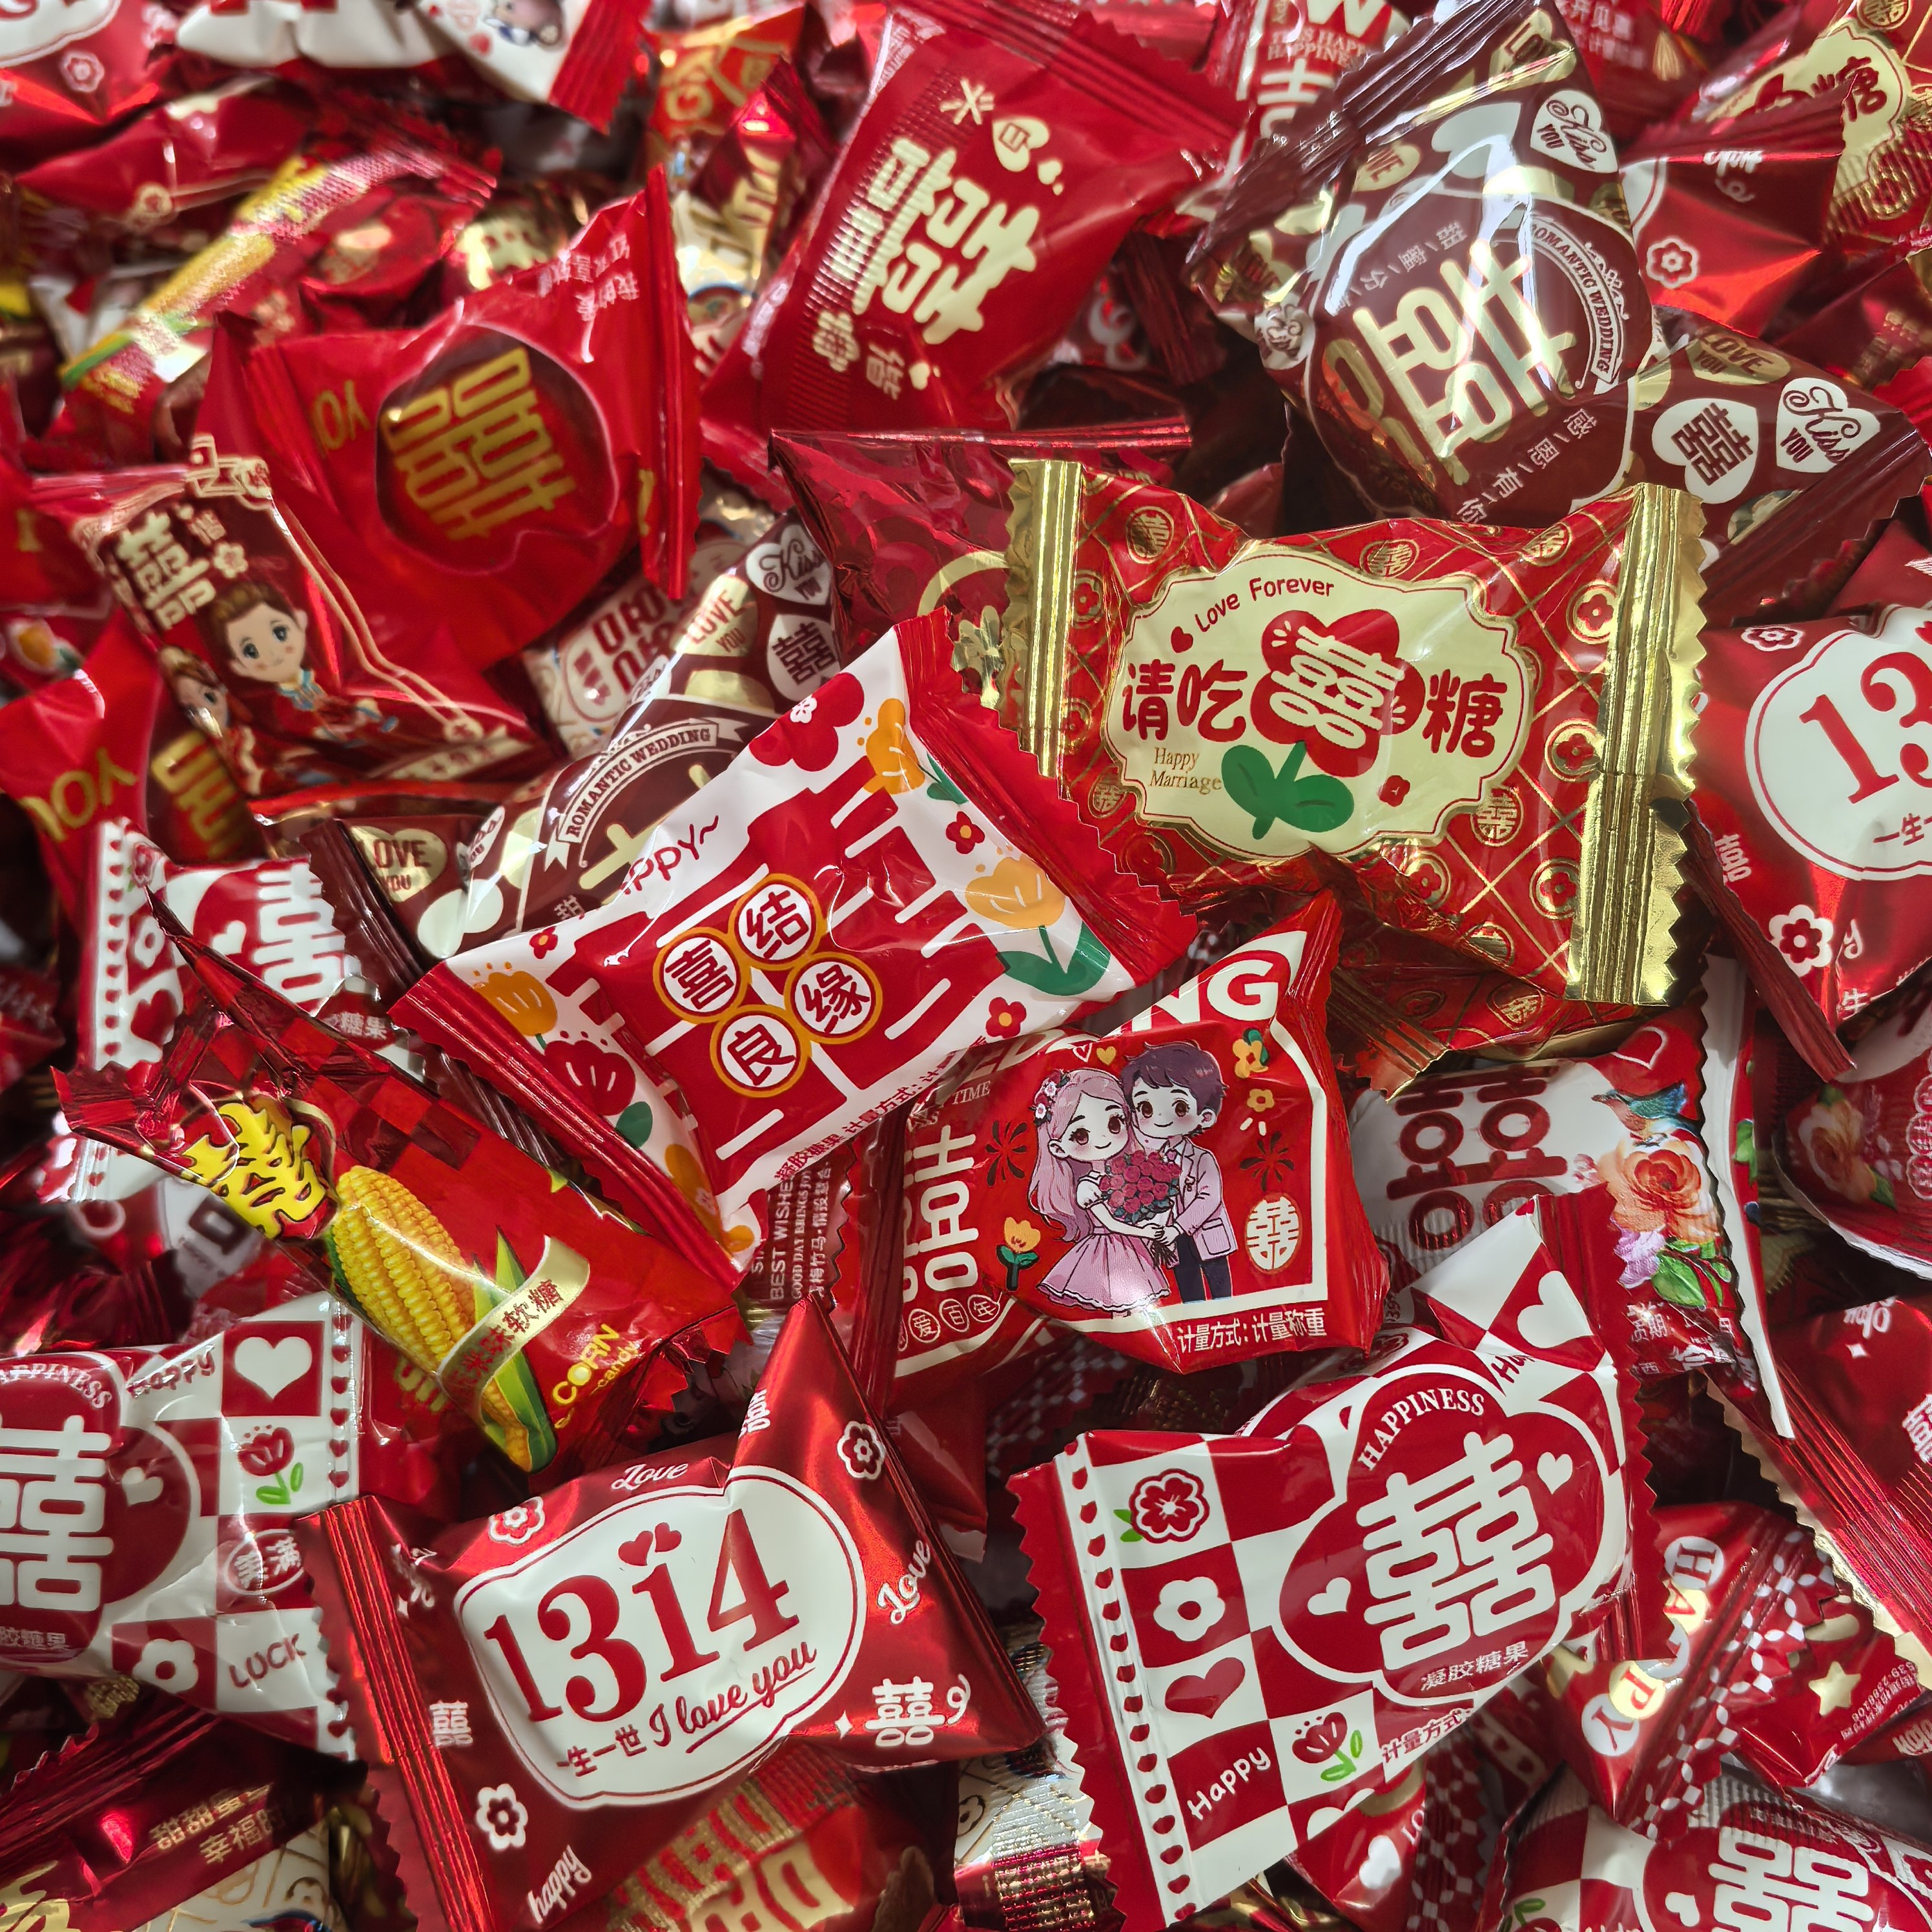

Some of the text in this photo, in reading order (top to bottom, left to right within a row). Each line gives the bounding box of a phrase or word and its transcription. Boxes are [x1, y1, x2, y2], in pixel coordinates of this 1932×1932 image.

[382, 347, 577, 540] 囍
[1670, 402, 1754, 486] 囍
[1194, 577, 1335, 633] Love Forever
[771, 620, 838, 686] 囍
[565, 757, 633, 838] ROMANTIC
[631, 727, 712, 764] WEDDING
[1147, 770, 1223, 796] Marriage
[1153, 746, 1201, 771] Happy
[951, 1080, 991, 1105] TIME
[770, 1246, 786, 1300] BEST
[553, 1324, 619, 1404] CORN
[1357, 1386, 1486, 1472] HAPPINESS
[610, 1461, 688, 1493] Love
[877, 1539, 932, 1625] Love
[1356, 1430, 1558, 1670] 囍
[228, 1632, 307, 1689] LUCK
[674, 1685, 749, 1736] love
[752, 1641, 818, 1707] you
[1421, 1639, 1530, 1692] 凝胶糖果
[865, 1675, 946, 1747] 囍
[557, 1723, 648, 1778] 一生一世
[1186, 1745, 1273, 1822] Happy
[528, 1844, 593, 1926] happy
